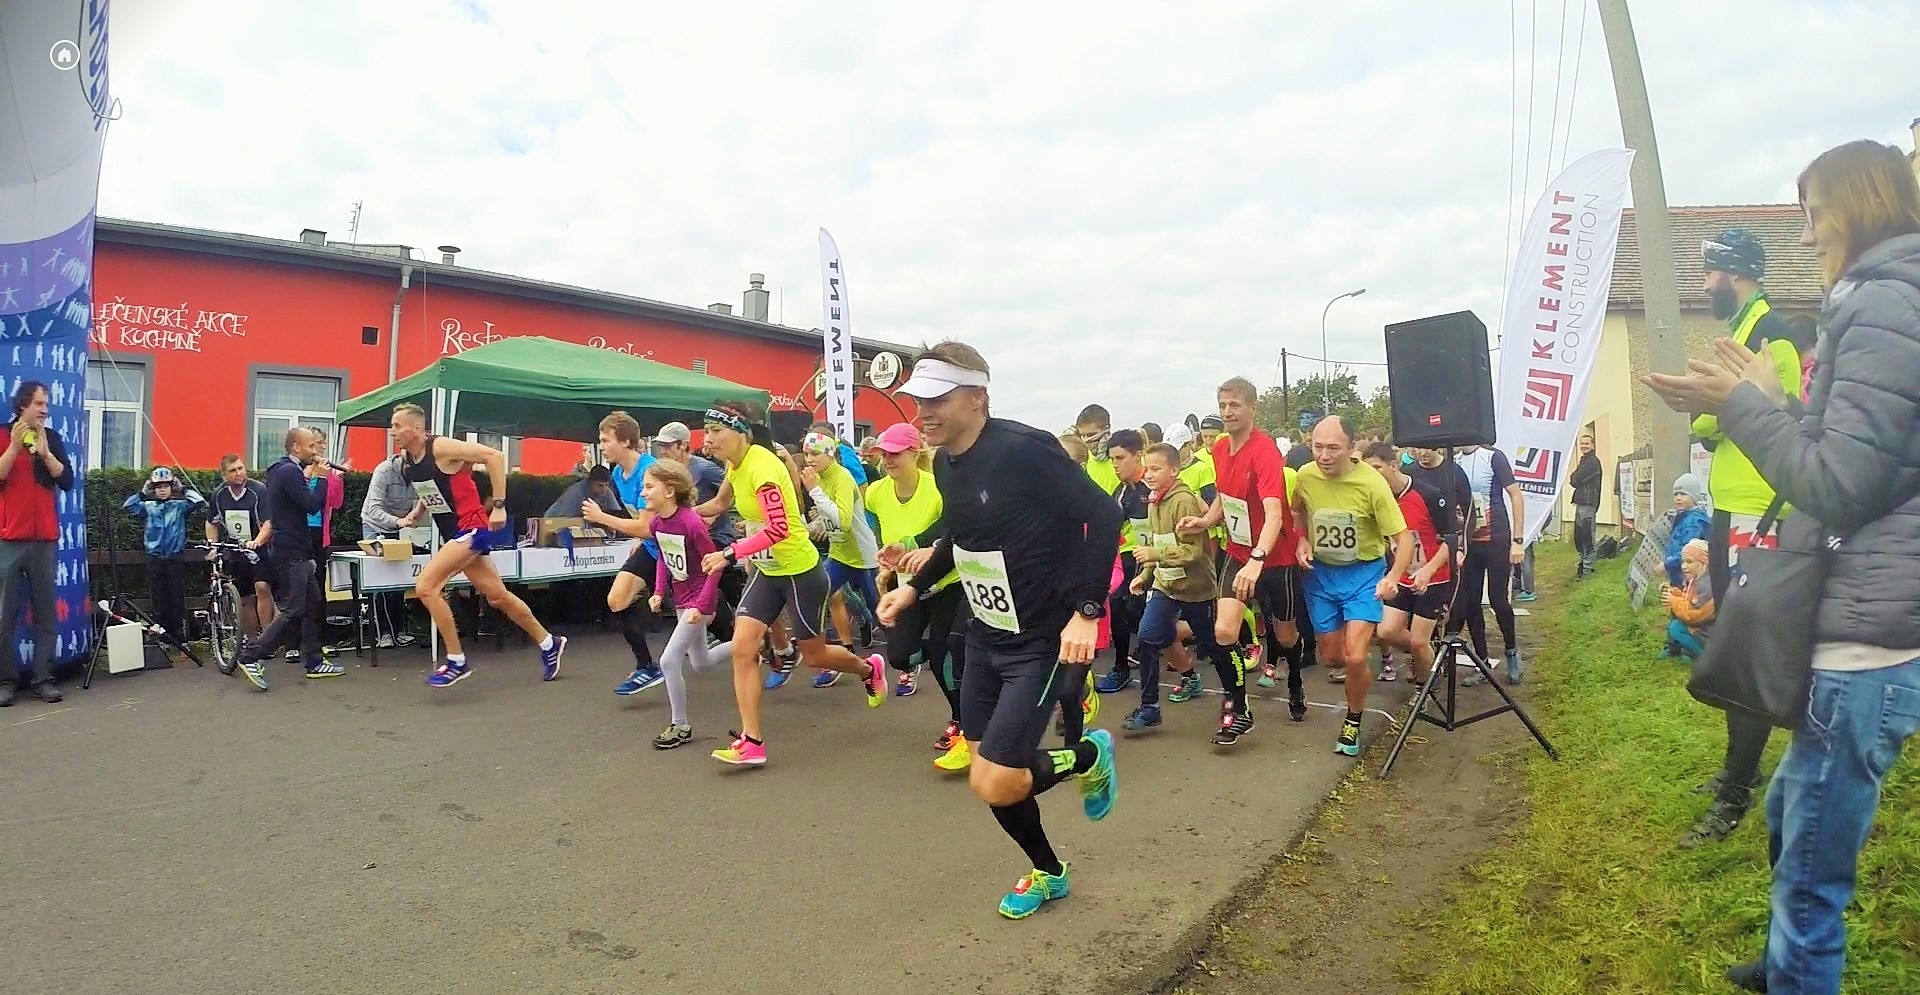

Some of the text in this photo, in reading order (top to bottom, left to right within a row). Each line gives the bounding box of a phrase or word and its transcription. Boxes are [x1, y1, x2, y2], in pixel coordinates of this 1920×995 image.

[1531, 190, 1575, 360] KLEMENT
[1561, 193, 1600, 364] CONSTRUCTION
[194, 310, 248, 337] AKCE
[118, 326, 202, 352] KUCHYNĚ
[422, 494, 443, 507] 185
[1518, 482, 1555, 494] LEMENT
[234, 522, 242, 534] 9
[1230, 515, 1239, 532] 7
[1316, 525, 1357, 549] 238
[965, 580, 1010, 612] 188
